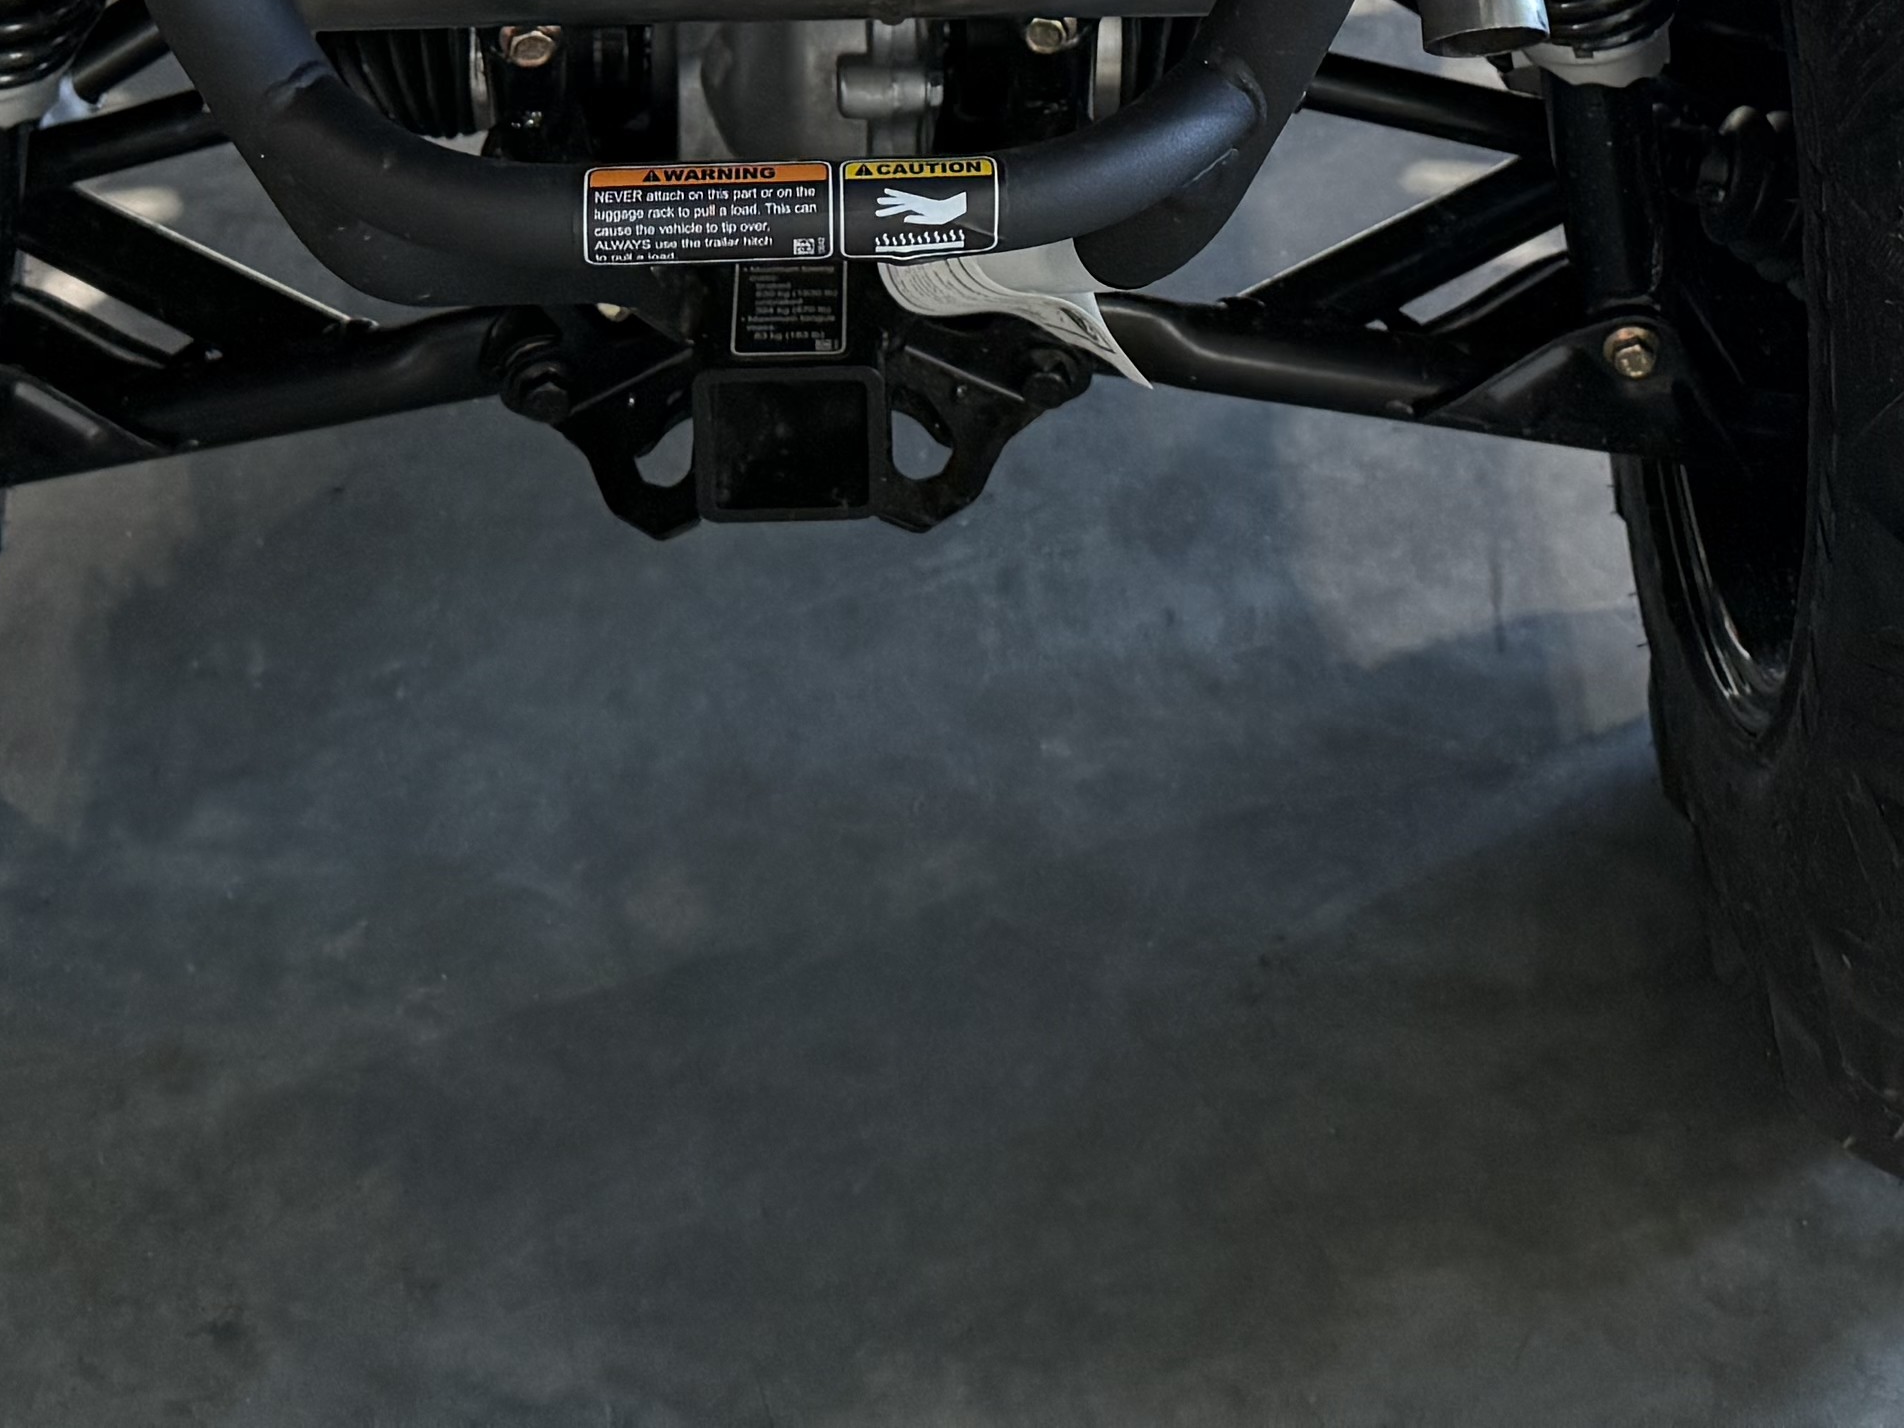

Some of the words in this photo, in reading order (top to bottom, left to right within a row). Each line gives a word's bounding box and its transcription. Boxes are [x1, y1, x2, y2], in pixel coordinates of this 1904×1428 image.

[664, 168, 776, 182] WARNING
[876, 161, 981, 175] CAUTION
[594, 190, 642, 204] NEVER
[646, 189, 684, 202] attach
[688, 191, 703, 200] on
[708, 188, 728, 199] this
[733, 188, 757, 202] part
[761, 189, 773, 198] or
[777, 189, 793, 198] on
[796, 186, 816, 197] the
[594, 208, 644, 222] luggage
[648, 207, 674, 218] rack
[677, 207, 690, 217] to
[693, 205, 716, 220] pull
[719, 207, 726, 216] a
[730, 204, 761, 216] load.
[764, 202, 791, 214] This
[795, 203, 817, 214] can
[594, 226, 632, 237] cause
[635, 223, 655, 235] the
[659, 223, 703, 234] vehicle
[706, 222, 718, 233] to
[722, 221, 736, 235] tip
[740, 222, 771, 233] over.
[594, 239, 651, 250] ALWAYS
[655, 240, 677, 249] use
[681, 237, 701, 248] the
[704, 236, 739, 247] trailer
[743, 235, 773, 246] hitch
[595, 251, 607, 261] to
